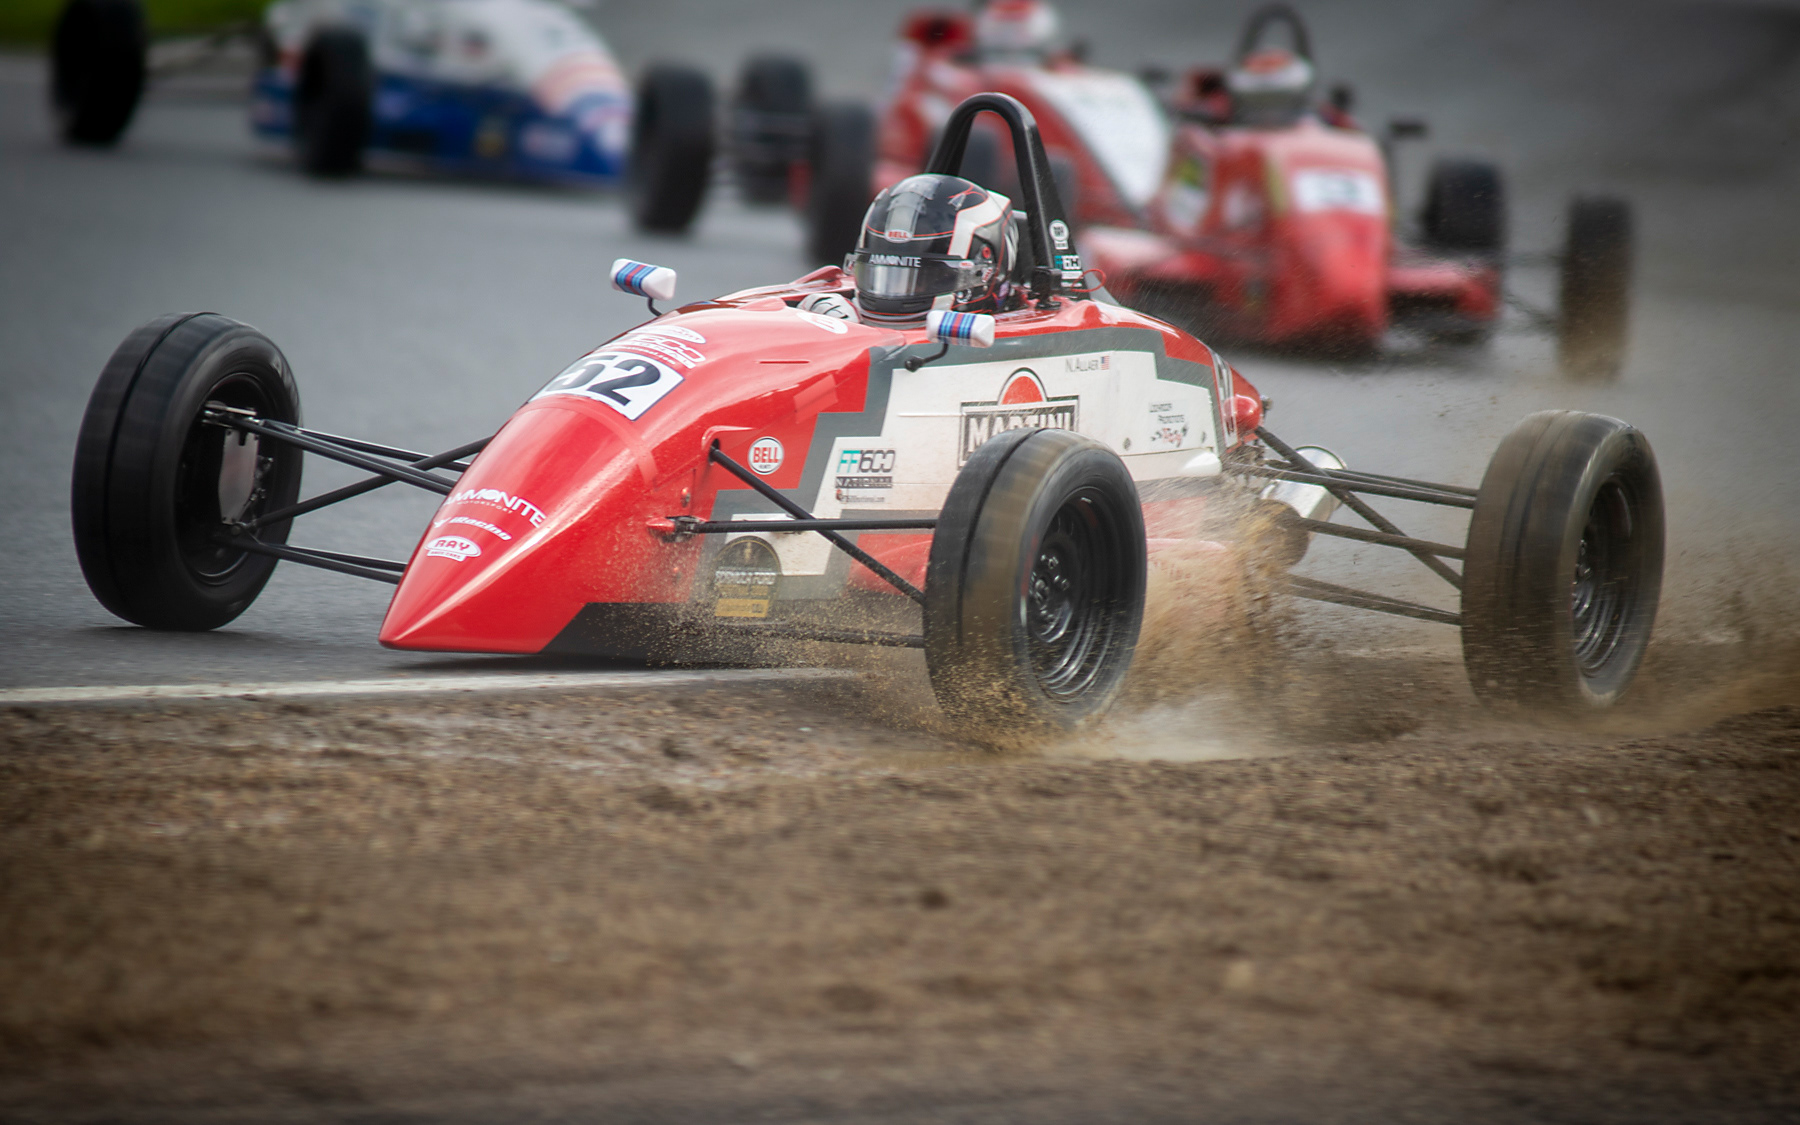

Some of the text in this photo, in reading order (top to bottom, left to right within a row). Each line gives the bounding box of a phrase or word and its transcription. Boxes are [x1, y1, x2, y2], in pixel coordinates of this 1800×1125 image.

[888, 231, 909, 239] BELL
[869, 254, 922, 268] AMMONITE
[544, 354, 661, 406] 52
[753, 446, 779, 464] BELL
[435, 539, 470, 551] RAY
